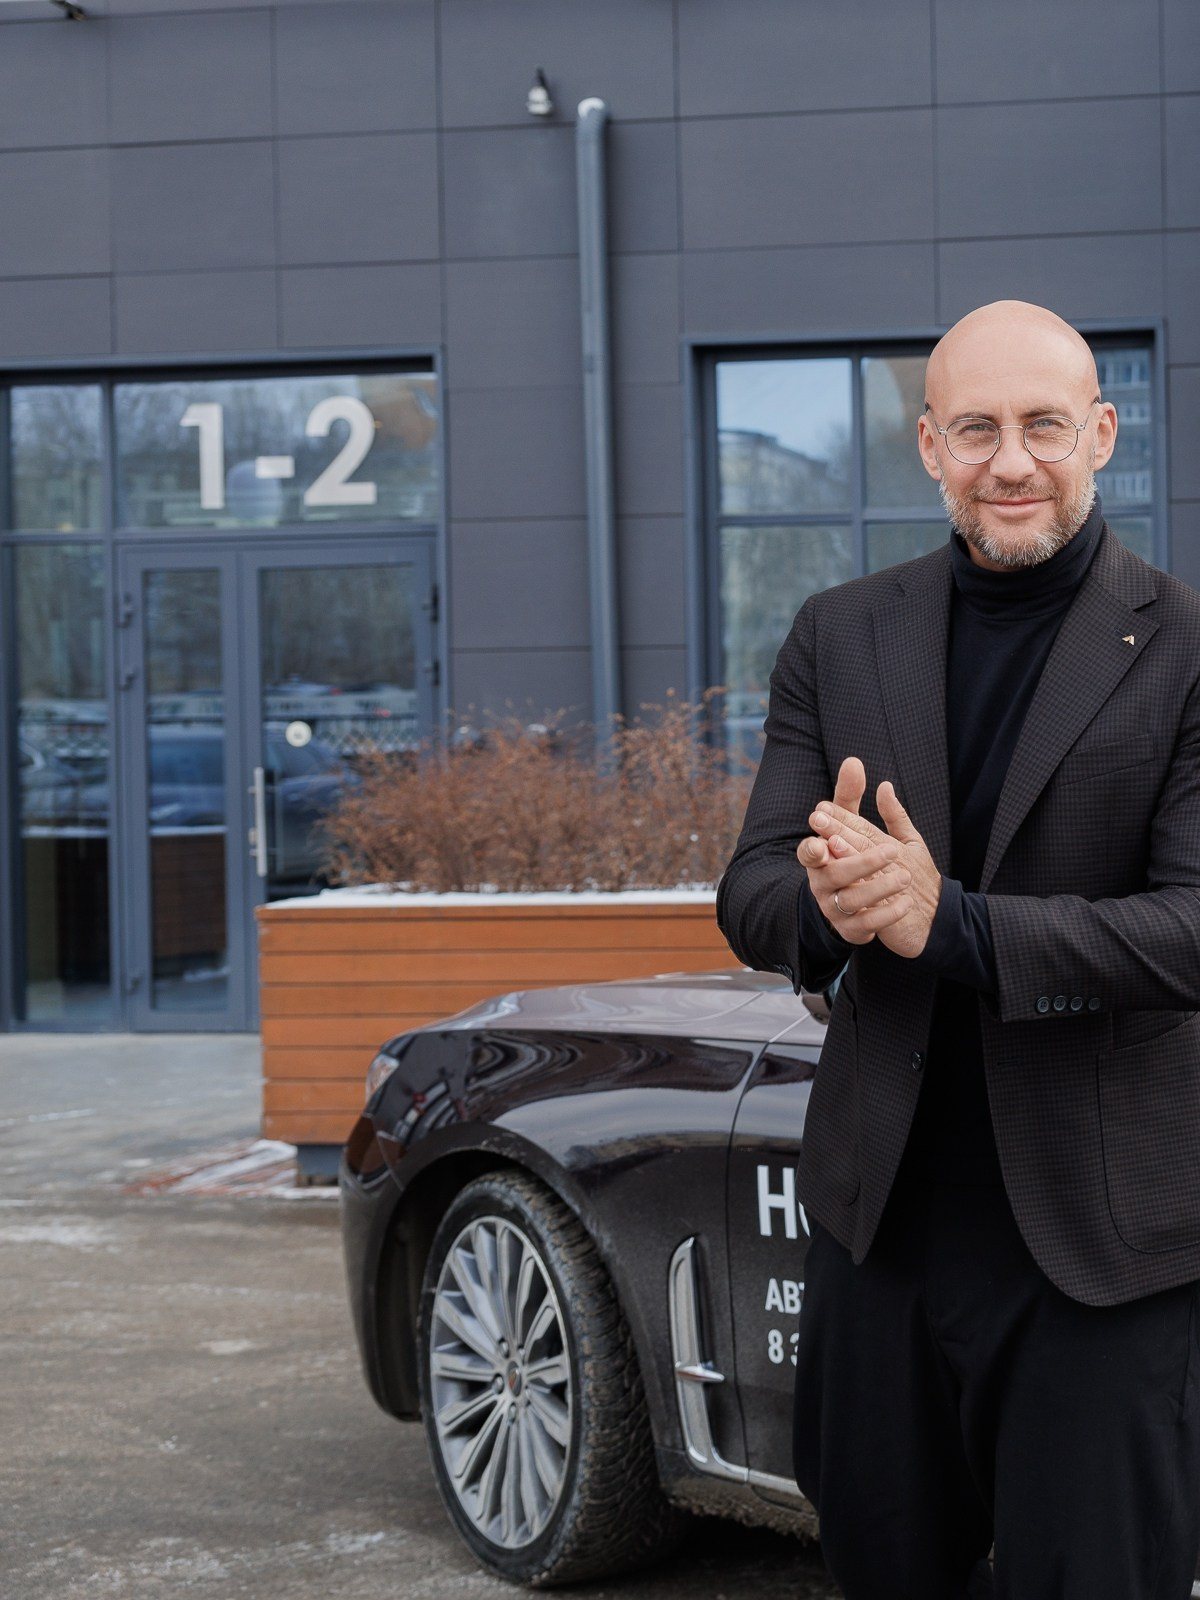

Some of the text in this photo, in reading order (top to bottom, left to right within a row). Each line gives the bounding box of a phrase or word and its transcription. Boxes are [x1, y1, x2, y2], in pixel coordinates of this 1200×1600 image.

[179, 396, 378, 510] 1-2
[757, 1164, 811, 1240] H
[767, 1328, 784, 1364] 8
